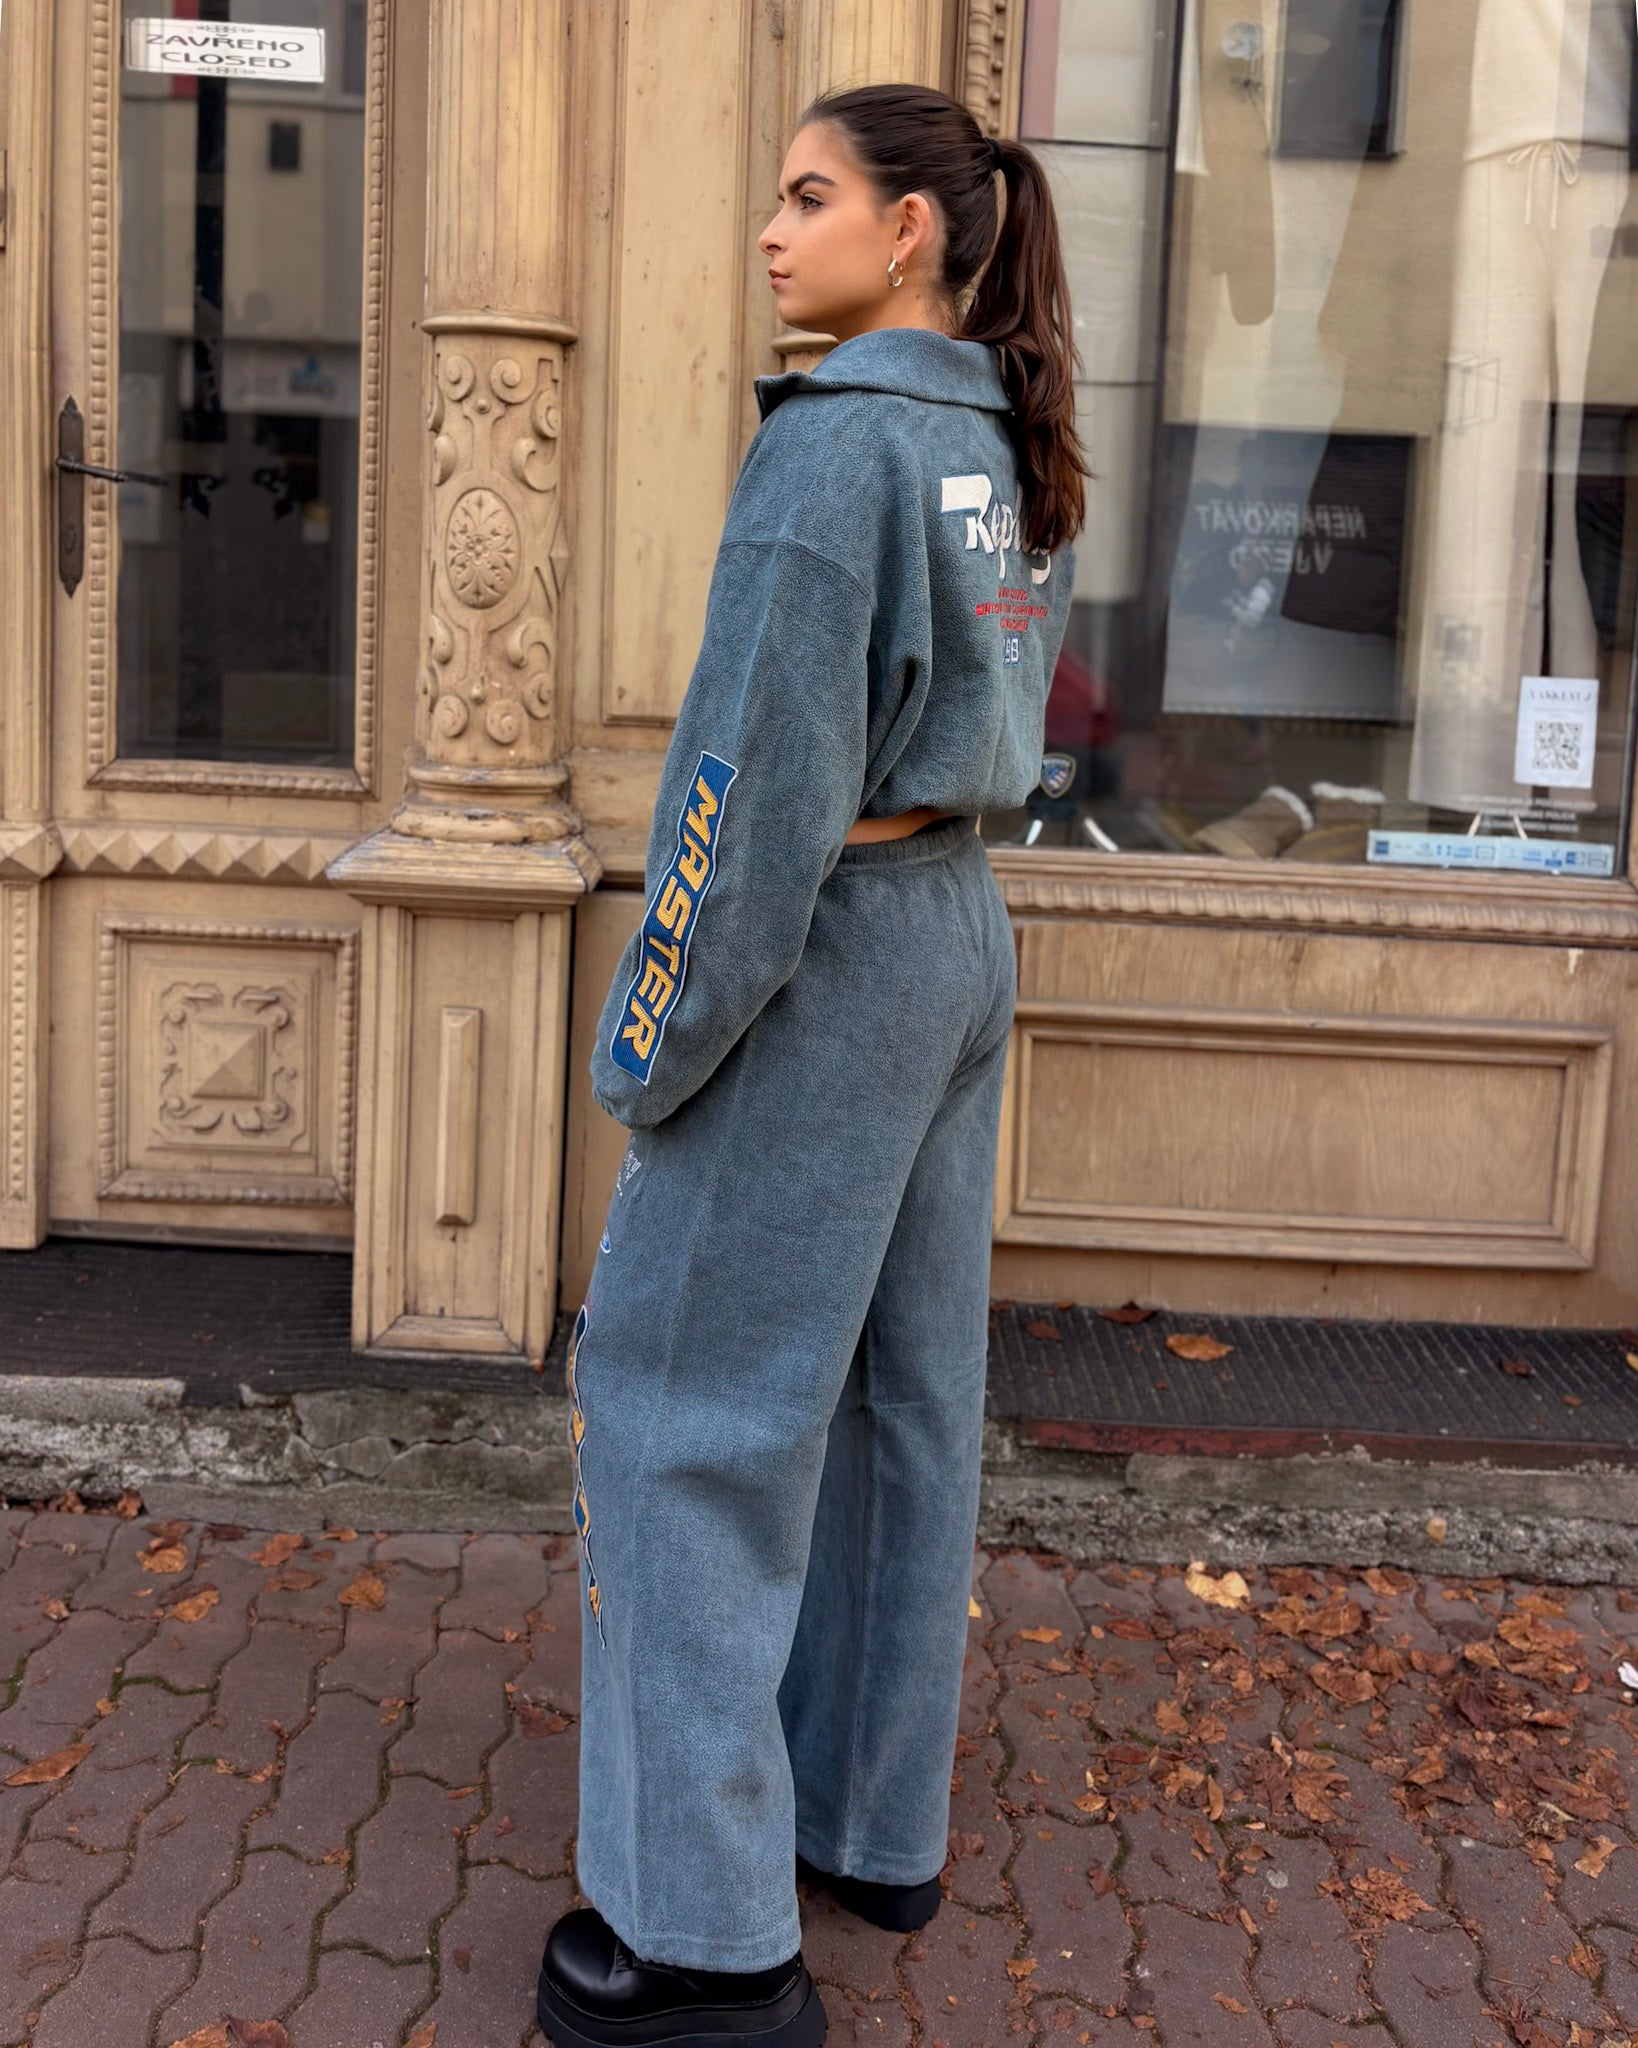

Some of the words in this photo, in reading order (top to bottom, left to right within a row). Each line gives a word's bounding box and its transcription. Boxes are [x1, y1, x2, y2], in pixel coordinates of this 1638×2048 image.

[146, 34, 304, 52] ZAVŘENO
[161, 52, 291, 69] CLOSED
[622, 776, 718, 1060] MASTER
